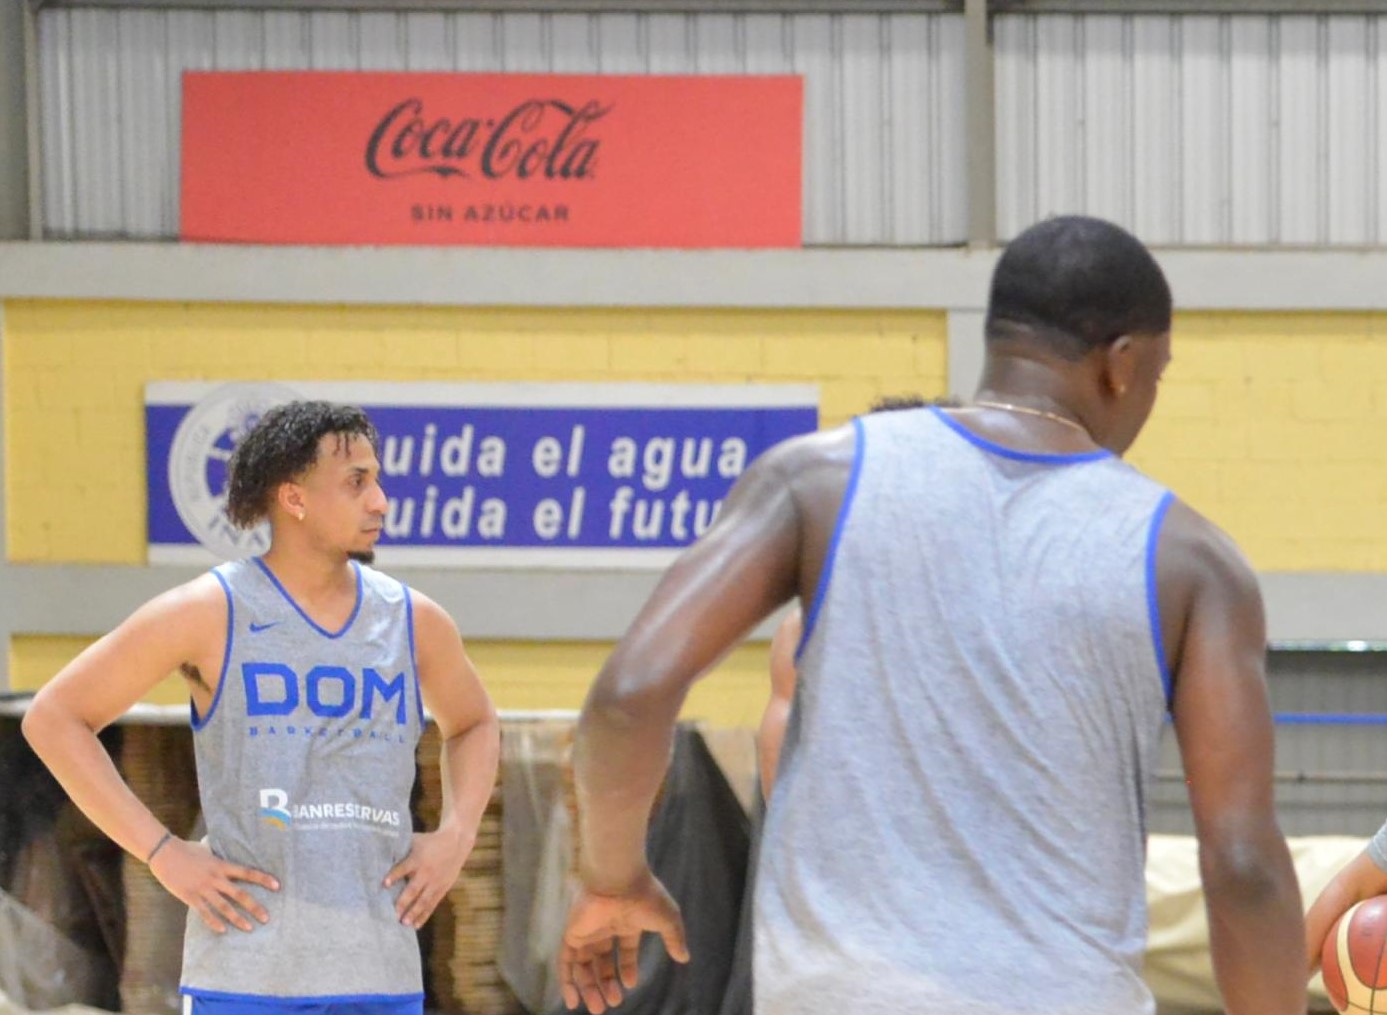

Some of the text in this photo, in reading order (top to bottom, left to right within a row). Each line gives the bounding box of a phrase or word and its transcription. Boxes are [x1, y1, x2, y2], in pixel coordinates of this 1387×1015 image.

[411, 204, 453, 221] SIN
[382, 422, 749, 491] uida el agua
[383, 484, 723, 541] uida el futu
[241, 662, 407, 725] DOM
